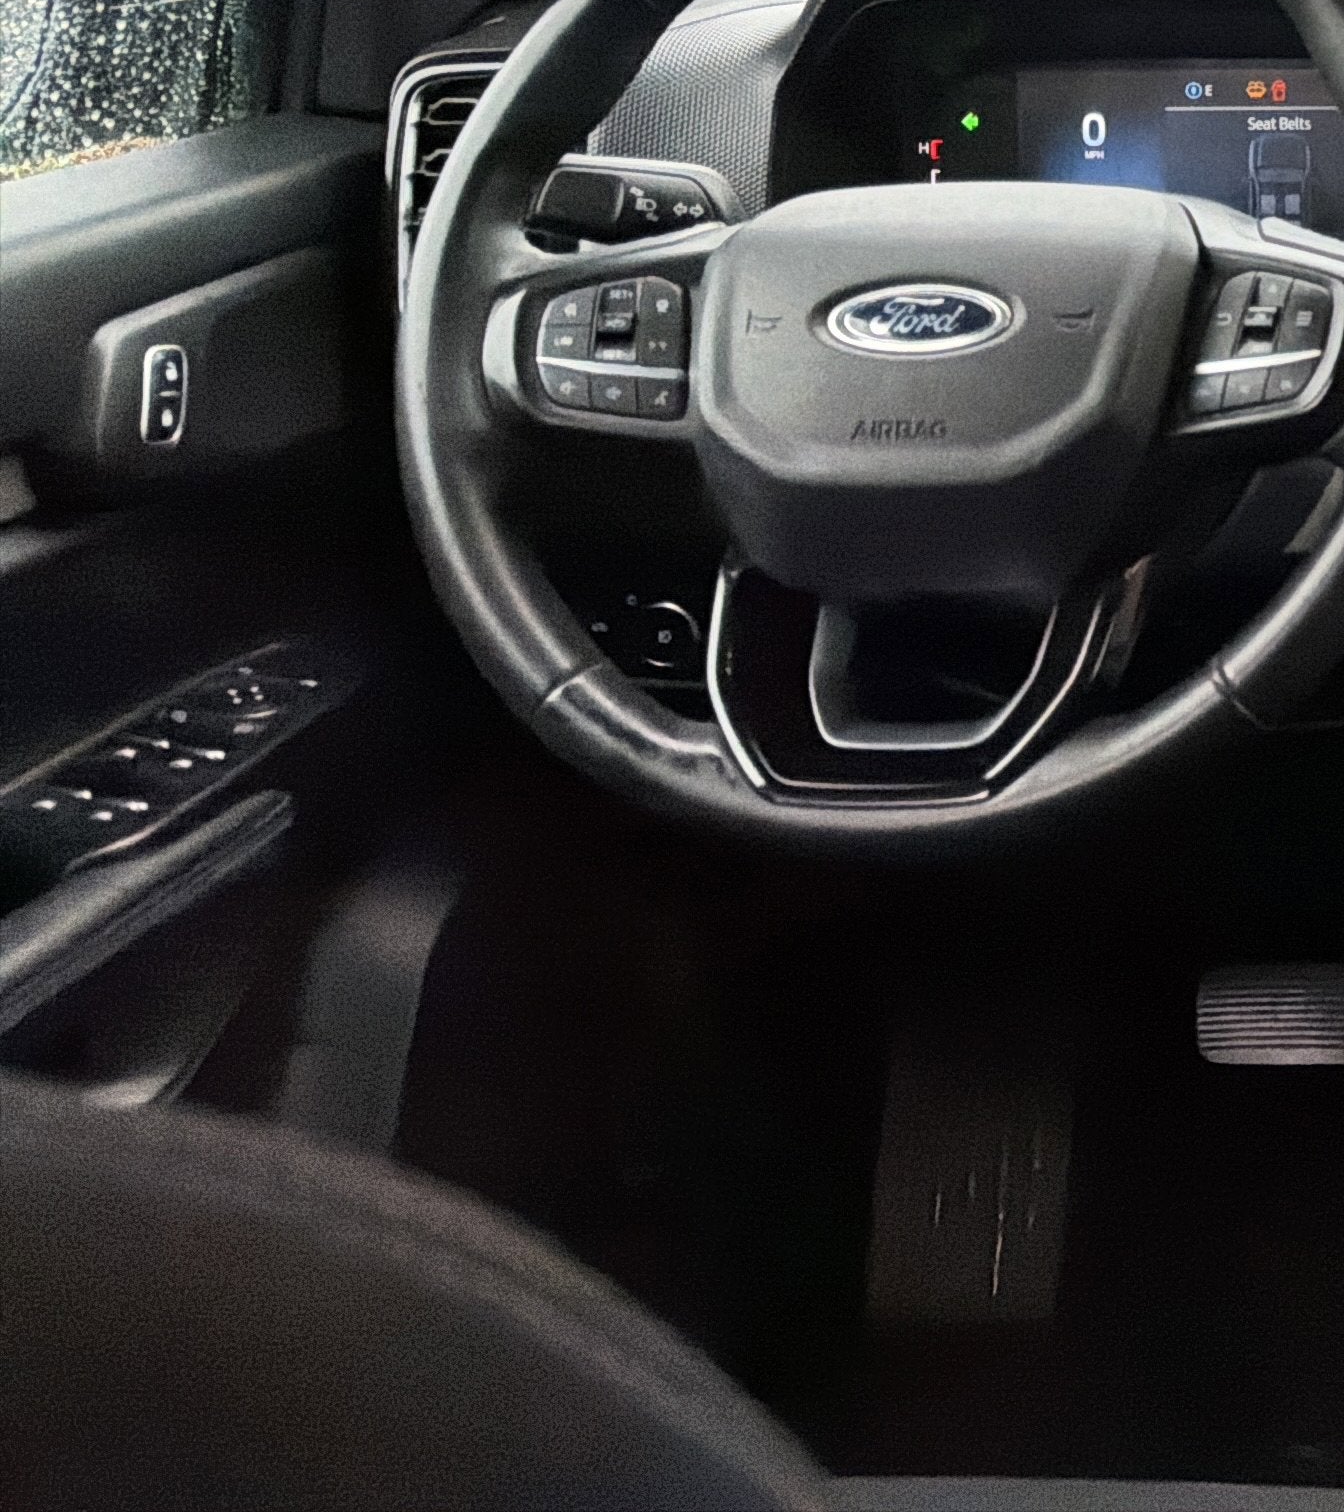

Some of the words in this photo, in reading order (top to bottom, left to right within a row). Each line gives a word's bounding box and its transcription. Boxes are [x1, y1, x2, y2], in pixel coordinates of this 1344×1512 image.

[1204, 84, 1213, 97] E
[1082, 112, 1106, 147] 0
[1247, 116, 1277, 131] Seat
[1279, 116, 1312, 131] Belts
[918, 141, 930, 155] H
[869, 296, 966, 336] Ford
[851, 418, 948, 441] AIRBAG
